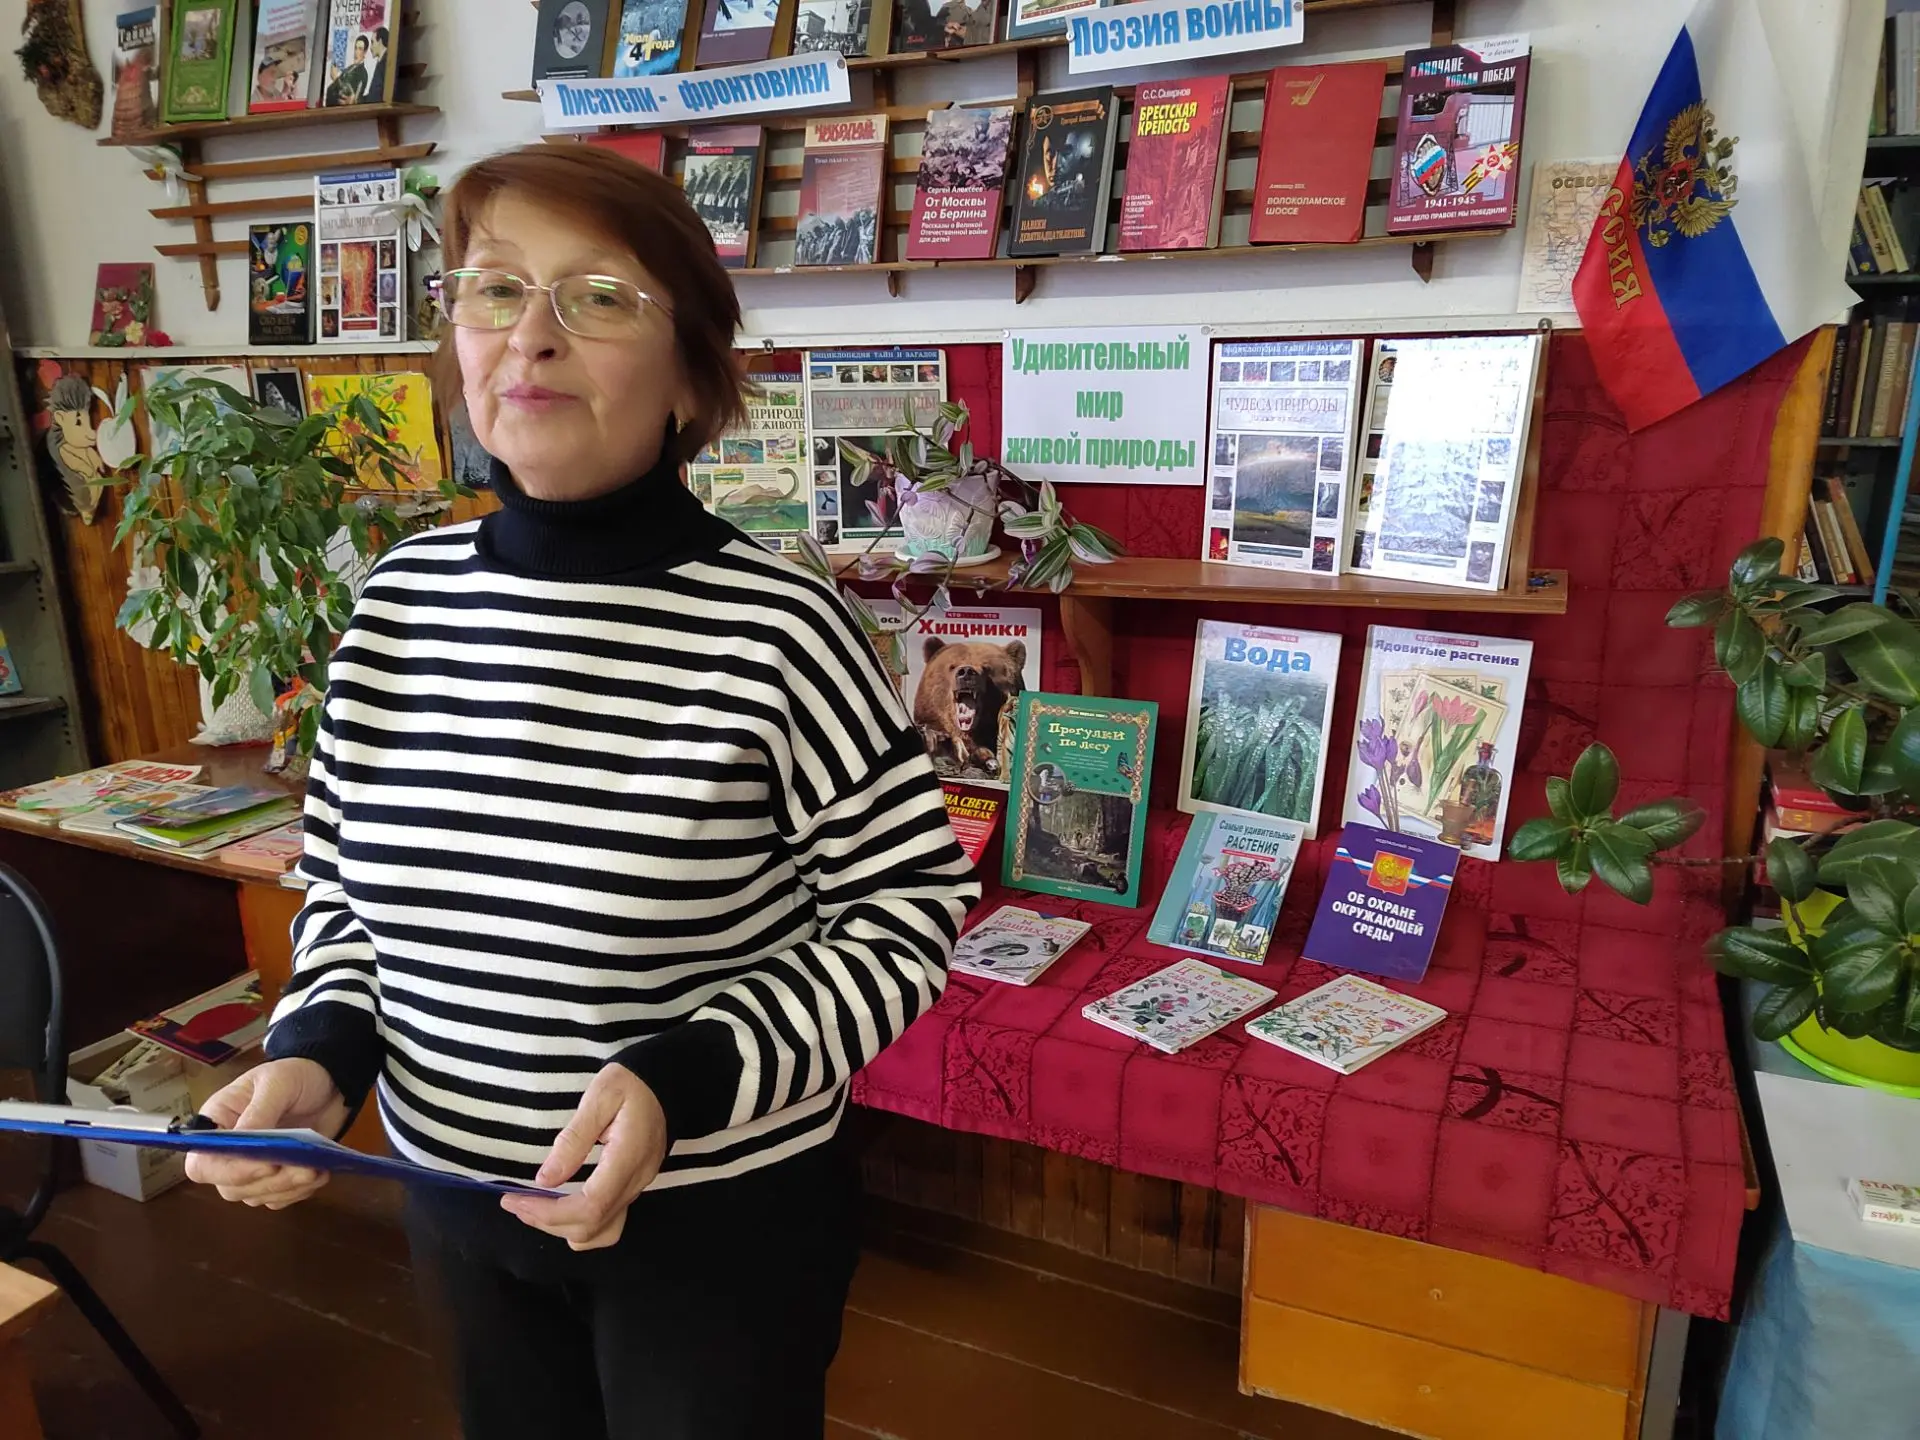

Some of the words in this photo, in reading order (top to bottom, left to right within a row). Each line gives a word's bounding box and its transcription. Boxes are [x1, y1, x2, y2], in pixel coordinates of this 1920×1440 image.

[1072, 10, 1180, 57] Поэзия
[652, 39, 675, 51] года
[1482, 66, 1517, 84] ПОБЕДУ
[677, 61, 832, 112] фронтовики
[1139, 102, 1198, 121] БРЕСТСКАЯ
[1137, 118, 1190, 137] КРЕПОСТЬ
[927, 186, 950, 194] Сергей
[925, 197, 940, 207] От
[941, 196, 986, 207] Москвы
[1267, 197, 1346, 206] ВОЛОКОЛАМСКОЕ
[1425, 196, 1477, 208] 1941-1945
[922, 210, 937, 220] до
[939, 208, 987, 221] Берлина
[1265, 207, 1299, 215] ШОССЕ
[1412, 213, 1429, 221] ДЕЛО
[1601, 187, 1643, 310] ССИЯ
[812, 351, 871, 359] ЭНЦИКЛОПЕДИЯ
[906, 350, 937, 358] ЗАГАДОК
[1011, 334, 1190, 375] Удивительный
[778, 373, 802, 382] ЧУДЕ
[815, 396, 867, 411] ЧУДЕСА
[871, 395, 936, 410] ПРИРДЫ
[1076, 391, 1124, 421] мир
[1226, 398, 1272, 413] ЧУДЕСА
[1275, 397, 1339, 413] ПРИРОДЫ
[761, 421, 805, 431] ЖИВОТН
[1006, 431, 1082, 465] живой
[1085, 437, 1196, 472] природы
[880, 616, 901, 624] ось
[917, 618, 1027, 638] Хищники
[1224, 637, 1311, 673] Вода
[1374, 639, 1447, 657] Ядовитые
[1450, 649, 1520, 666] растения
[1048, 722, 1126, 741] Прогулки
[944, 793, 959, 806] НА
[960, 796, 998, 811] СВЕТЕ
[948, 806, 993, 820] ОТВЕТАХ
[1219, 820, 1244, 834] Самые
[1243, 824, 1296, 842] удивительные
[1225, 835, 1280, 855] РАСТЕНИЯ
[1347, 891, 1365, 905] ОБ
[1367, 896, 1417, 920] ОХРАНЕ
[1332, 901, 1424, 936] ОКРУЖАЮЩЕЙ
[1352, 921, 1394, 942] СРЕДЫ
